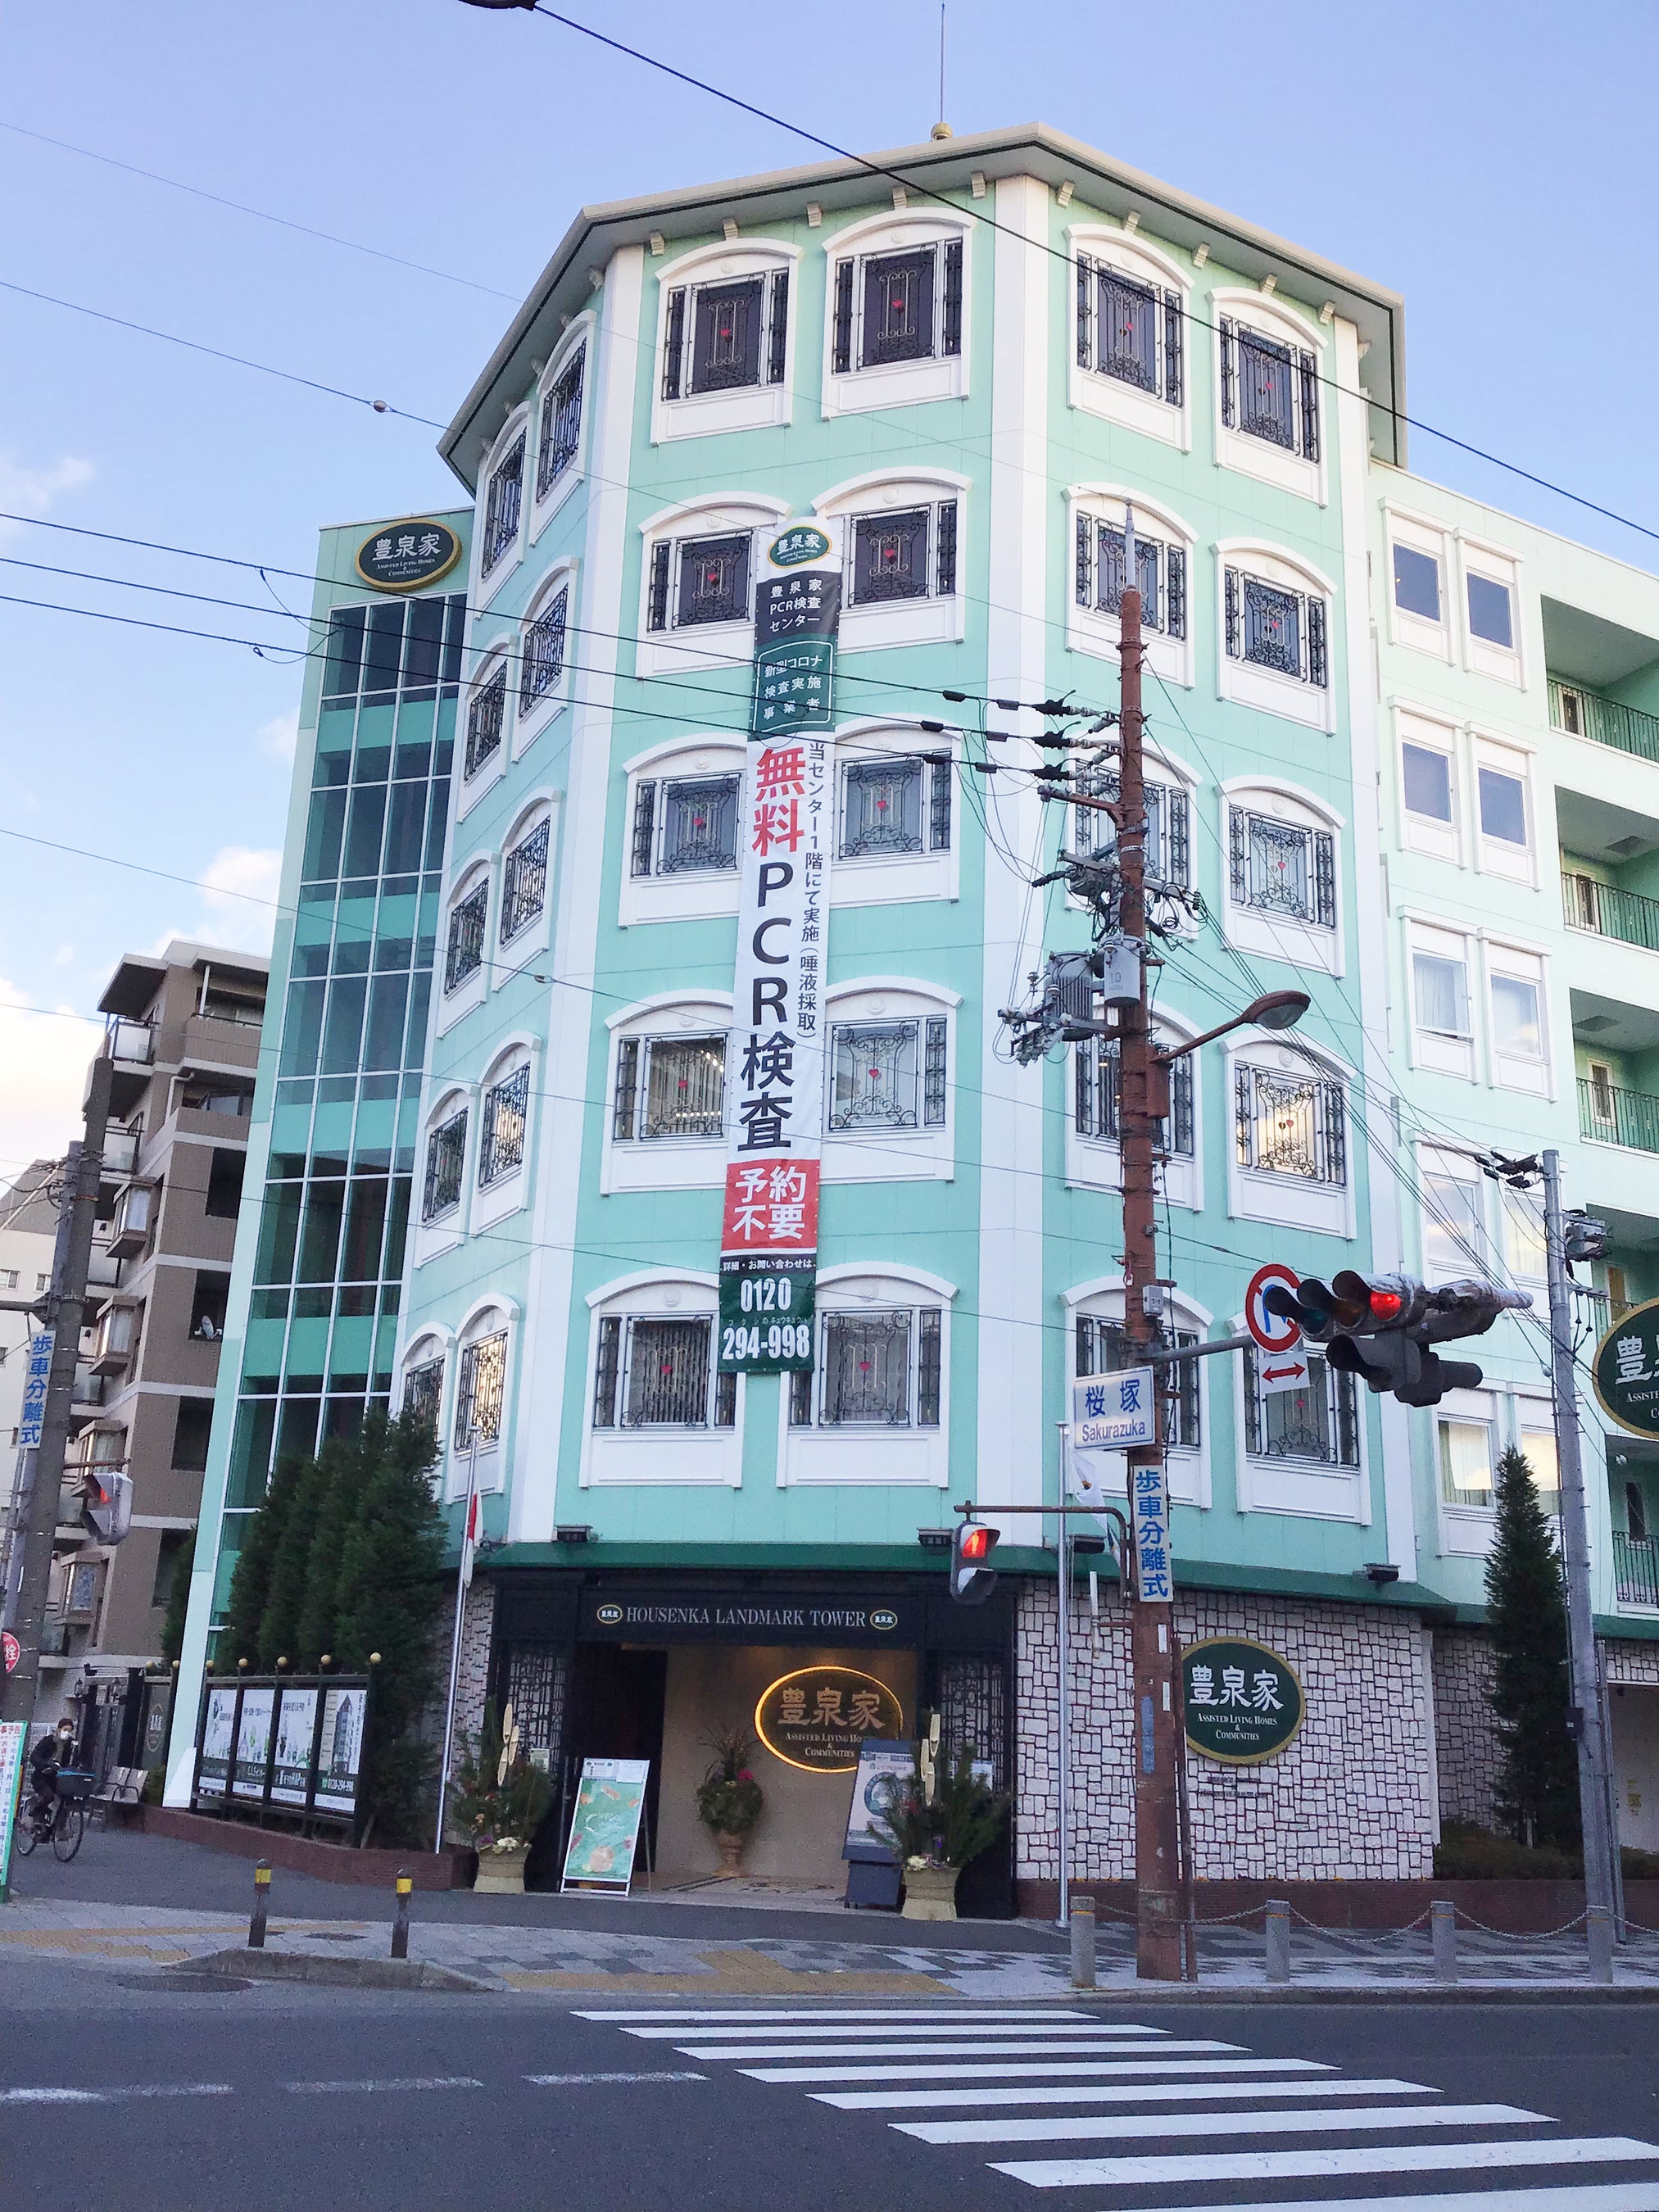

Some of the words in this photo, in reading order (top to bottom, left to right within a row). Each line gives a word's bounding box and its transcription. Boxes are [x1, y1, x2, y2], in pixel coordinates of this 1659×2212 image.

[372, 533, 442, 561] 豊泉家
[777, 533, 821, 555] 豊泉家
[770, 578, 822, 598] 豊泉家
[770, 596, 821, 615] PCR検査
[769, 614, 821, 632] センター
[764, 655, 823, 678] 新型コロナ
[764, 675, 822, 699] 検査実施
[764, 697, 820, 719] 事業者
[735, 1166, 807, 1203] 予約
[732, 1203, 806, 1240] 不要
[723, 1258, 813, 1271] 詳細・お問い合わせは
[741, 1276, 791, 1312] 0120
[722, 1324, 809, 1360] 294-998
[20, 1335, 53, 1444] 歩車分離式
[1085, 1379, 1141, 1418] 桜塚
[1081, 1420, 1145, 1442] Sakurazuka
[1135, 1470, 1168, 1598] 歩車分離式
[626, 1607, 709, 1623] HOUSENKA
[716, 1608, 805, 1625] LANDMARK
[809, 1610, 866, 1627] TOWER
[1189, 1664, 1285, 1711] 豊泉家
[777, 1687, 886, 1730] 豊泉家
[1197, 1712, 1229, 1723] ASSISTED
[1230, 1714, 1253, 1725] LIVING
[1254, 1716, 1278, 1725] HOMES
[786, 1732, 820, 1742] ASSISTED
[822, 1733, 849, 1743] LIVING
[1215, 1729, 1260, 1740] COMMUNITIES
[805, 1747, 855, 1757] COMMUNITIES
